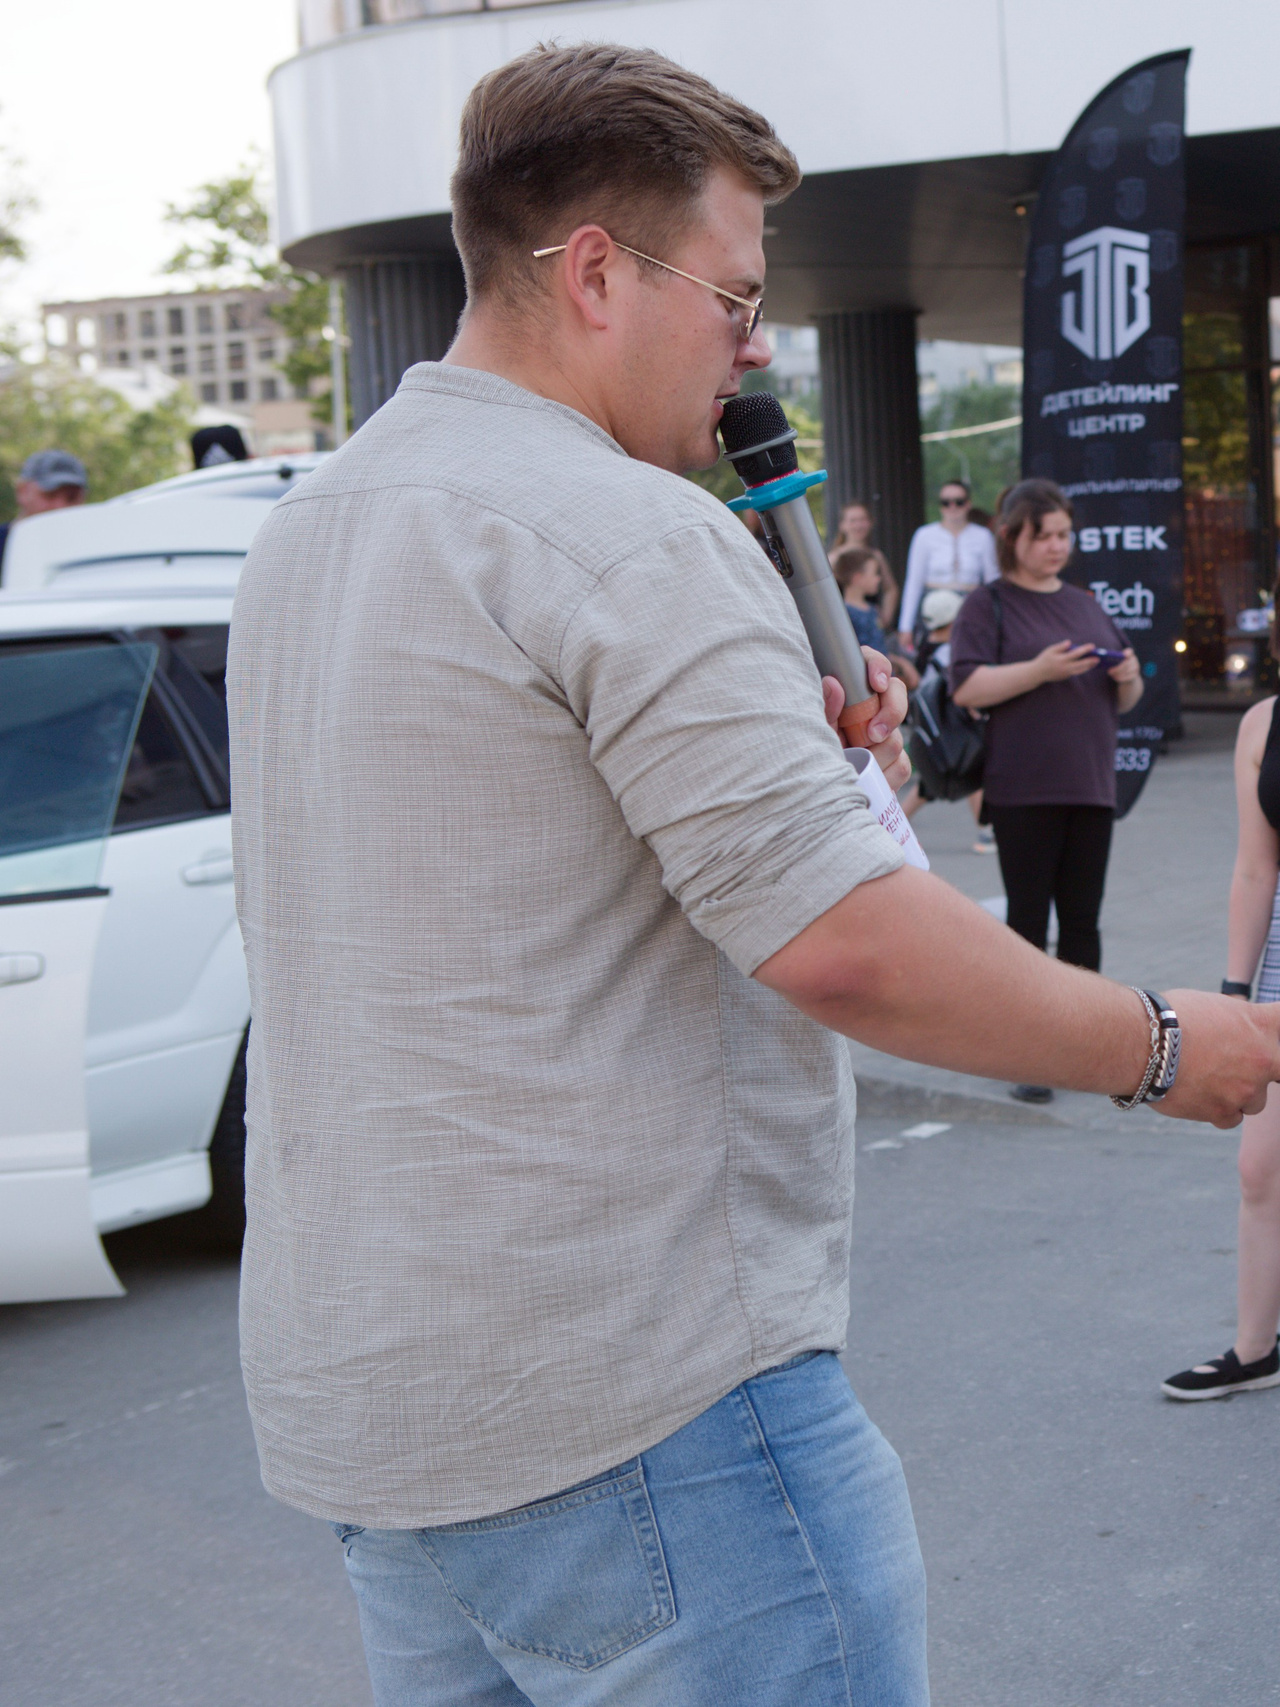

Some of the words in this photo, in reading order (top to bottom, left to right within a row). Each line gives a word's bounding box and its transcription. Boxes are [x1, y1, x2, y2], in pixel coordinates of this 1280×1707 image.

[1040, 381, 1179, 417] ДЕТЕЙЛИНГ
[1067, 412, 1146, 439] ЦЕНТР
[1079, 525, 1168, 552] STEK
